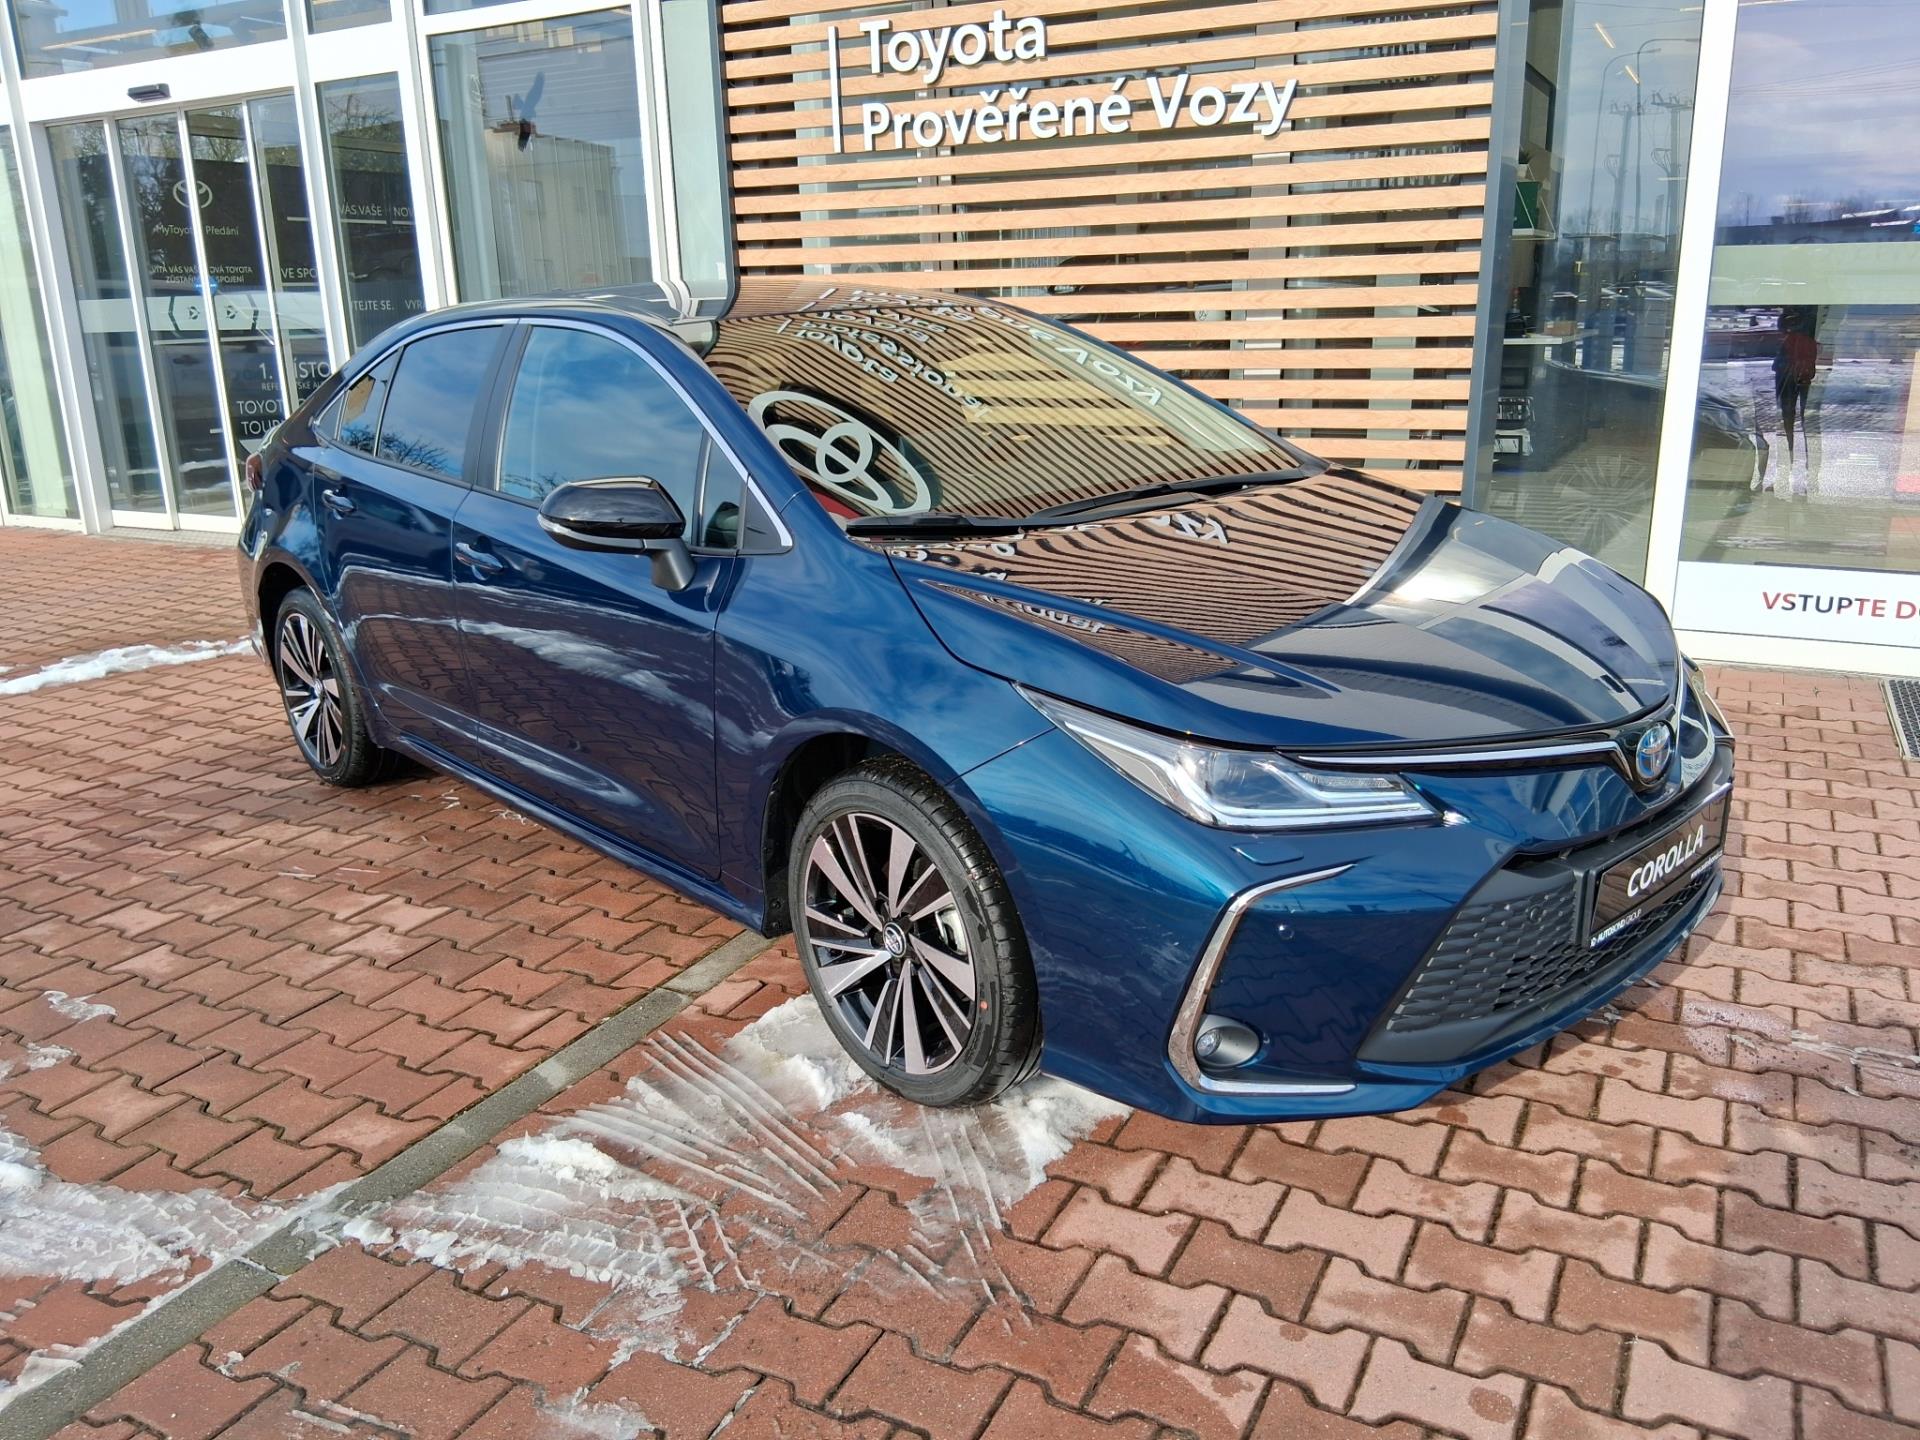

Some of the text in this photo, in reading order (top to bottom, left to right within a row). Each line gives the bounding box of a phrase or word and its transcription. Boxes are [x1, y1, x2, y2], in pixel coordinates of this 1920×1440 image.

[860, 10, 1047, 83] Toyota
[862, 74, 1298, 152] Prověřené Vozy
[358, 204, 382, 216] VAŠE
[393, 206, 414, 218] NOV
[205, 225, 239, 236] Předání
[225, 266, 252, 274] TOYOTA
[259, 358, 331, 379] 1. ÍSTO
[235, 399, 283, 415] TOYOT
[1762, 591, 1920, 620] VSTUPTE D
[1626, 824, 1704, 898] COROLLA
